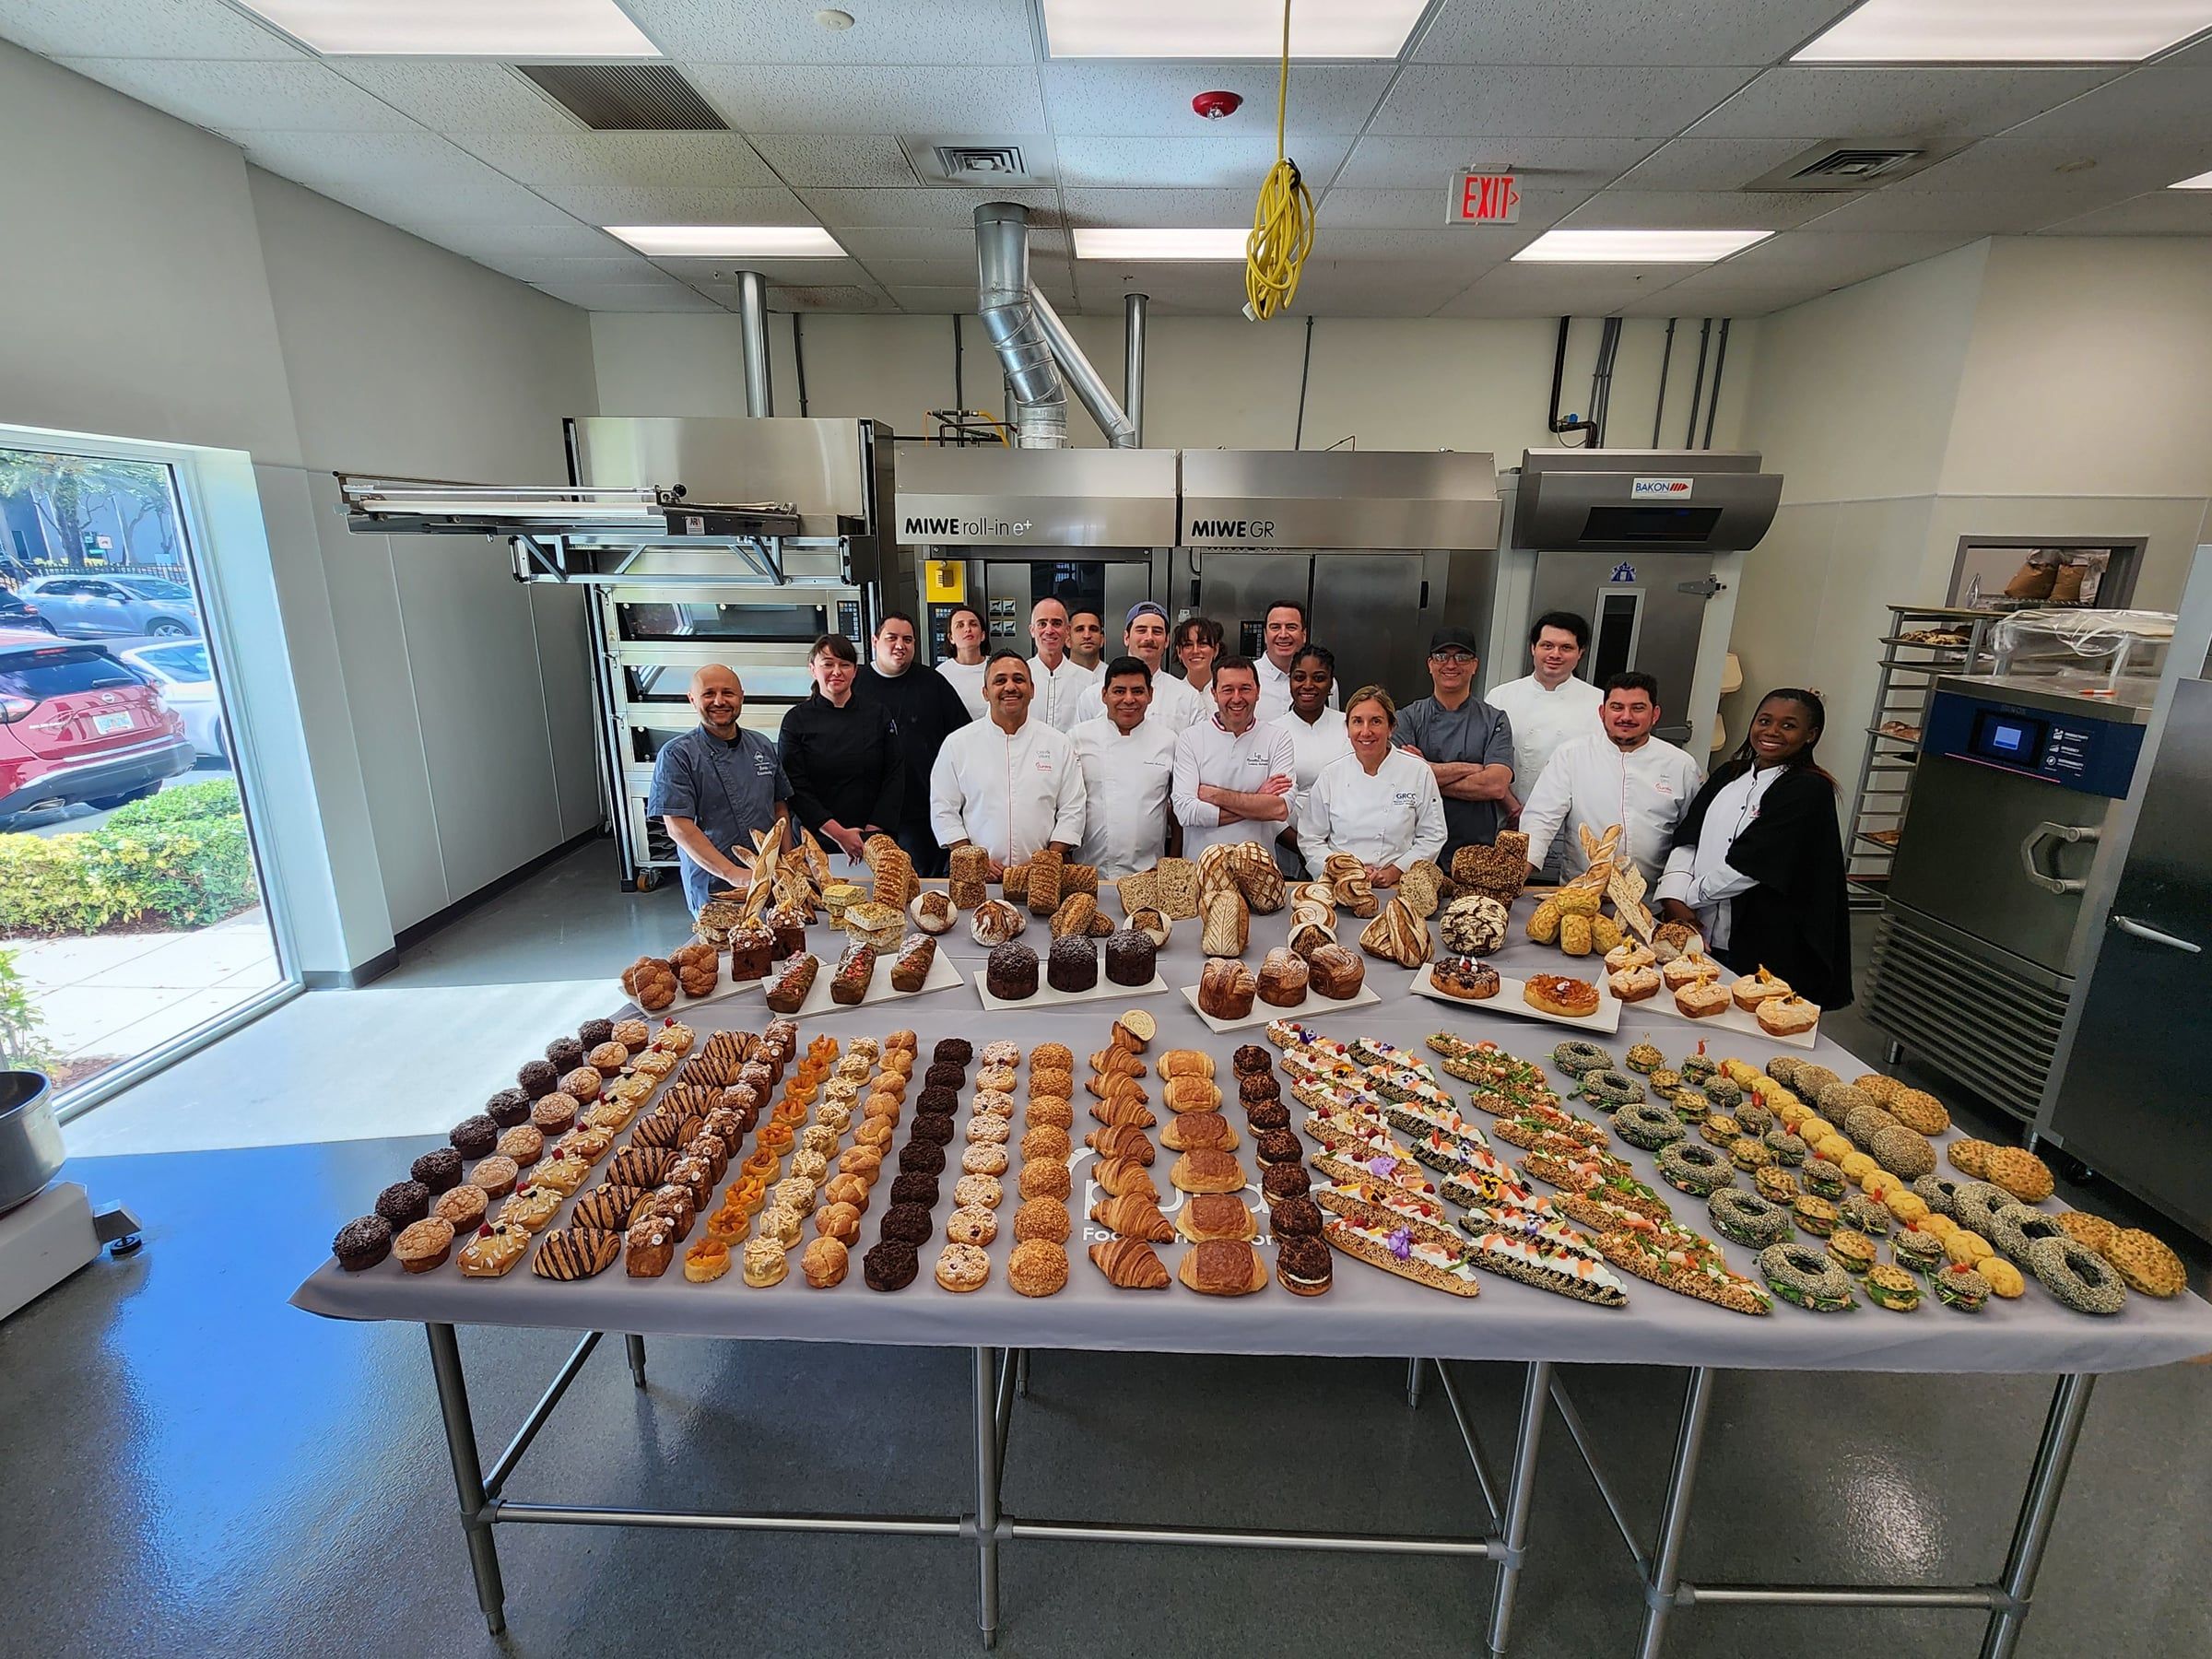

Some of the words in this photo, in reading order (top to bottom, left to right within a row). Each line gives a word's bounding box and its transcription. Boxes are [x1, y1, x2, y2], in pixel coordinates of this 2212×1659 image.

[1462, 176, 1514, 218] EXIT
[1636, 482, 1670, 491] BAKON
[905, 517, 959, 535] MIWE
[963, 517, 1009, 535] roll-in
[1192, 520, 1247, 537] MIWE
[1250, 521, 1275, 537] GR
